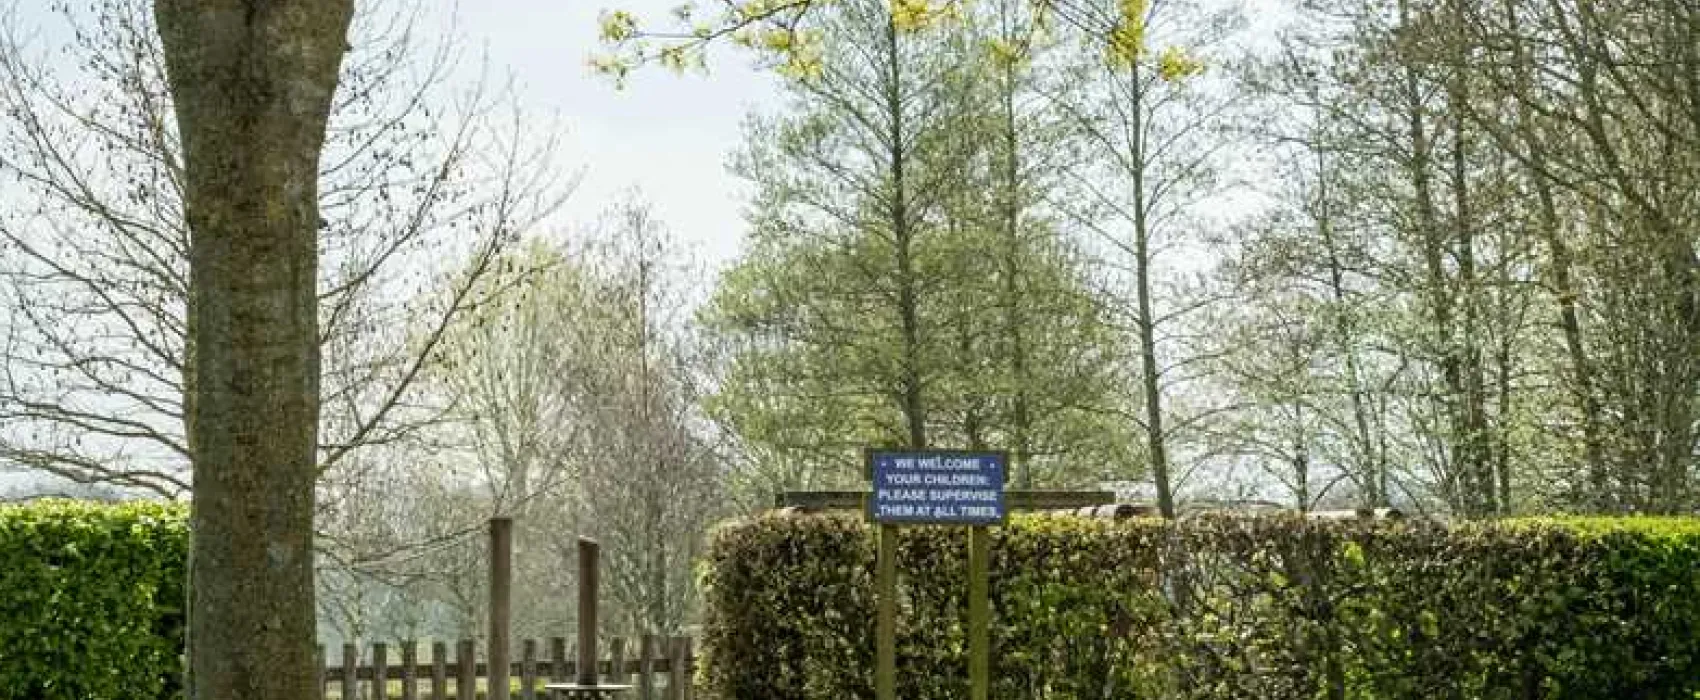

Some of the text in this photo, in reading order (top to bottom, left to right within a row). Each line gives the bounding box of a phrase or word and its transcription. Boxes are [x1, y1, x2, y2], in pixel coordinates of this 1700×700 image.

[895, 457, 980, 469] WE WELCOME
[886, 473, 921, 484] YOUR
[879, 489, 997, 501] PLEASE SUPERVISE
[881, 505, 996, 517] THEM AT ALL TIMES
